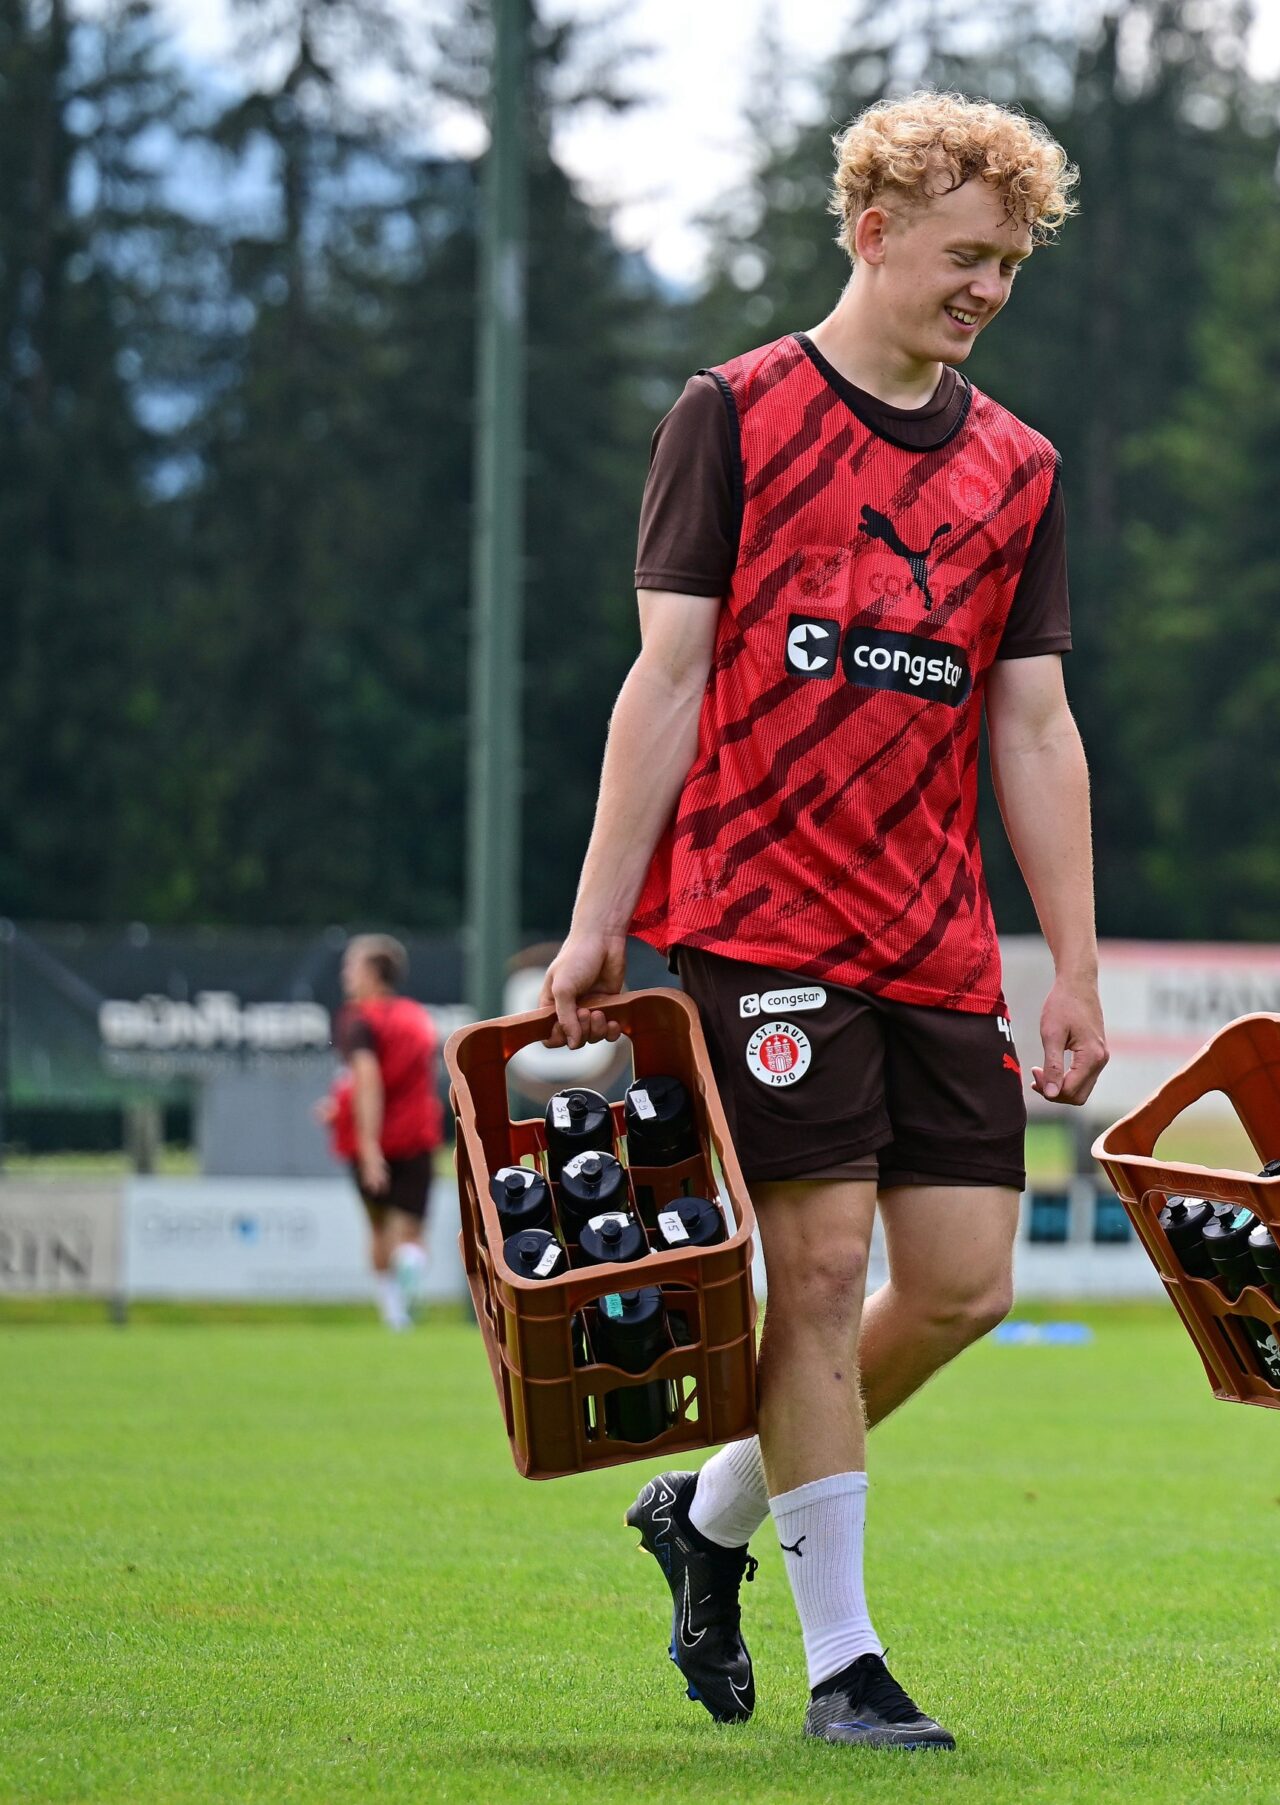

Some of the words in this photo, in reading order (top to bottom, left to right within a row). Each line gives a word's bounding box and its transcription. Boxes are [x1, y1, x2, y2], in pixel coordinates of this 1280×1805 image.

[853, 645, 963, 688] congsta
[767, 992, 821, 1007] congstar
[749, 1043, 758, 1056] FC
[756, 1028, 772, 1041] ST.
[775, 1024, 808, 1048] PAULI
[771, 1072, 796, 1084] 1910
